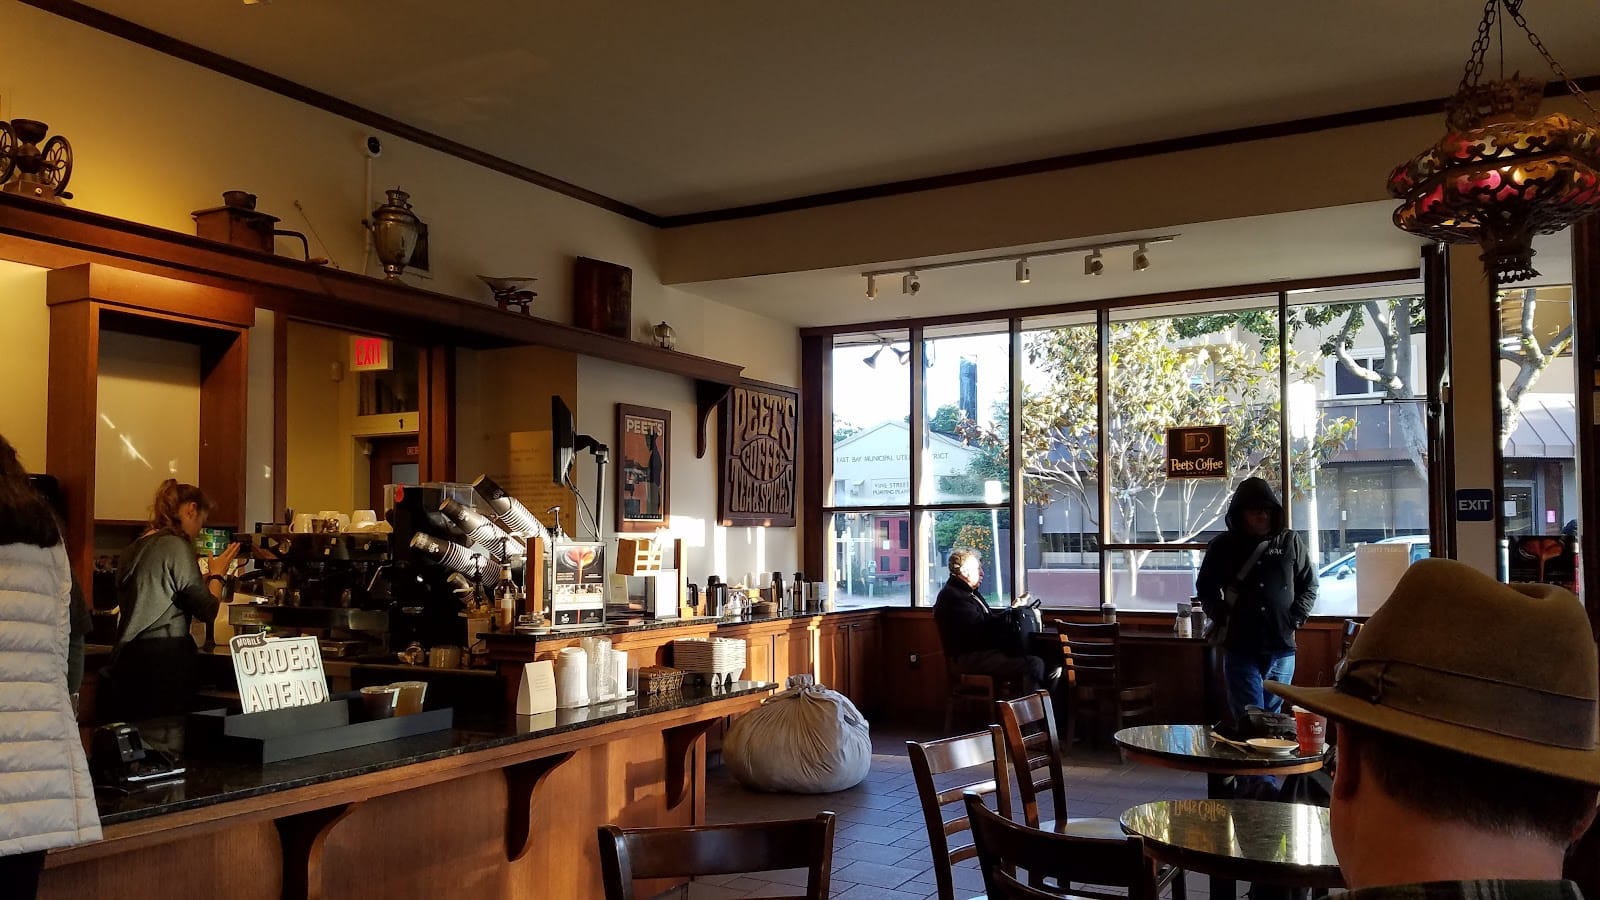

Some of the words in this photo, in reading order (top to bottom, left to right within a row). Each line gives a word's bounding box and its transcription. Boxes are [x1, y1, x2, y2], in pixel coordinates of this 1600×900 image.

[355, 338, 382, 366] EXIT
[398, 418, 404, 429] 1
[626, 418, 662, 436] PEET'S
[733, 387, 795, 461] PEET'S
[742, 438, 785, 481] COFFEE
[1195, 457, 1223, 471] Coffee
[1459, 500, 1490, 510] EXIT
[236, 636, 261, 647] MOBILE
[240, 645, 318, 676] ORDER
[248, 680, 325, 712] AHEAD
